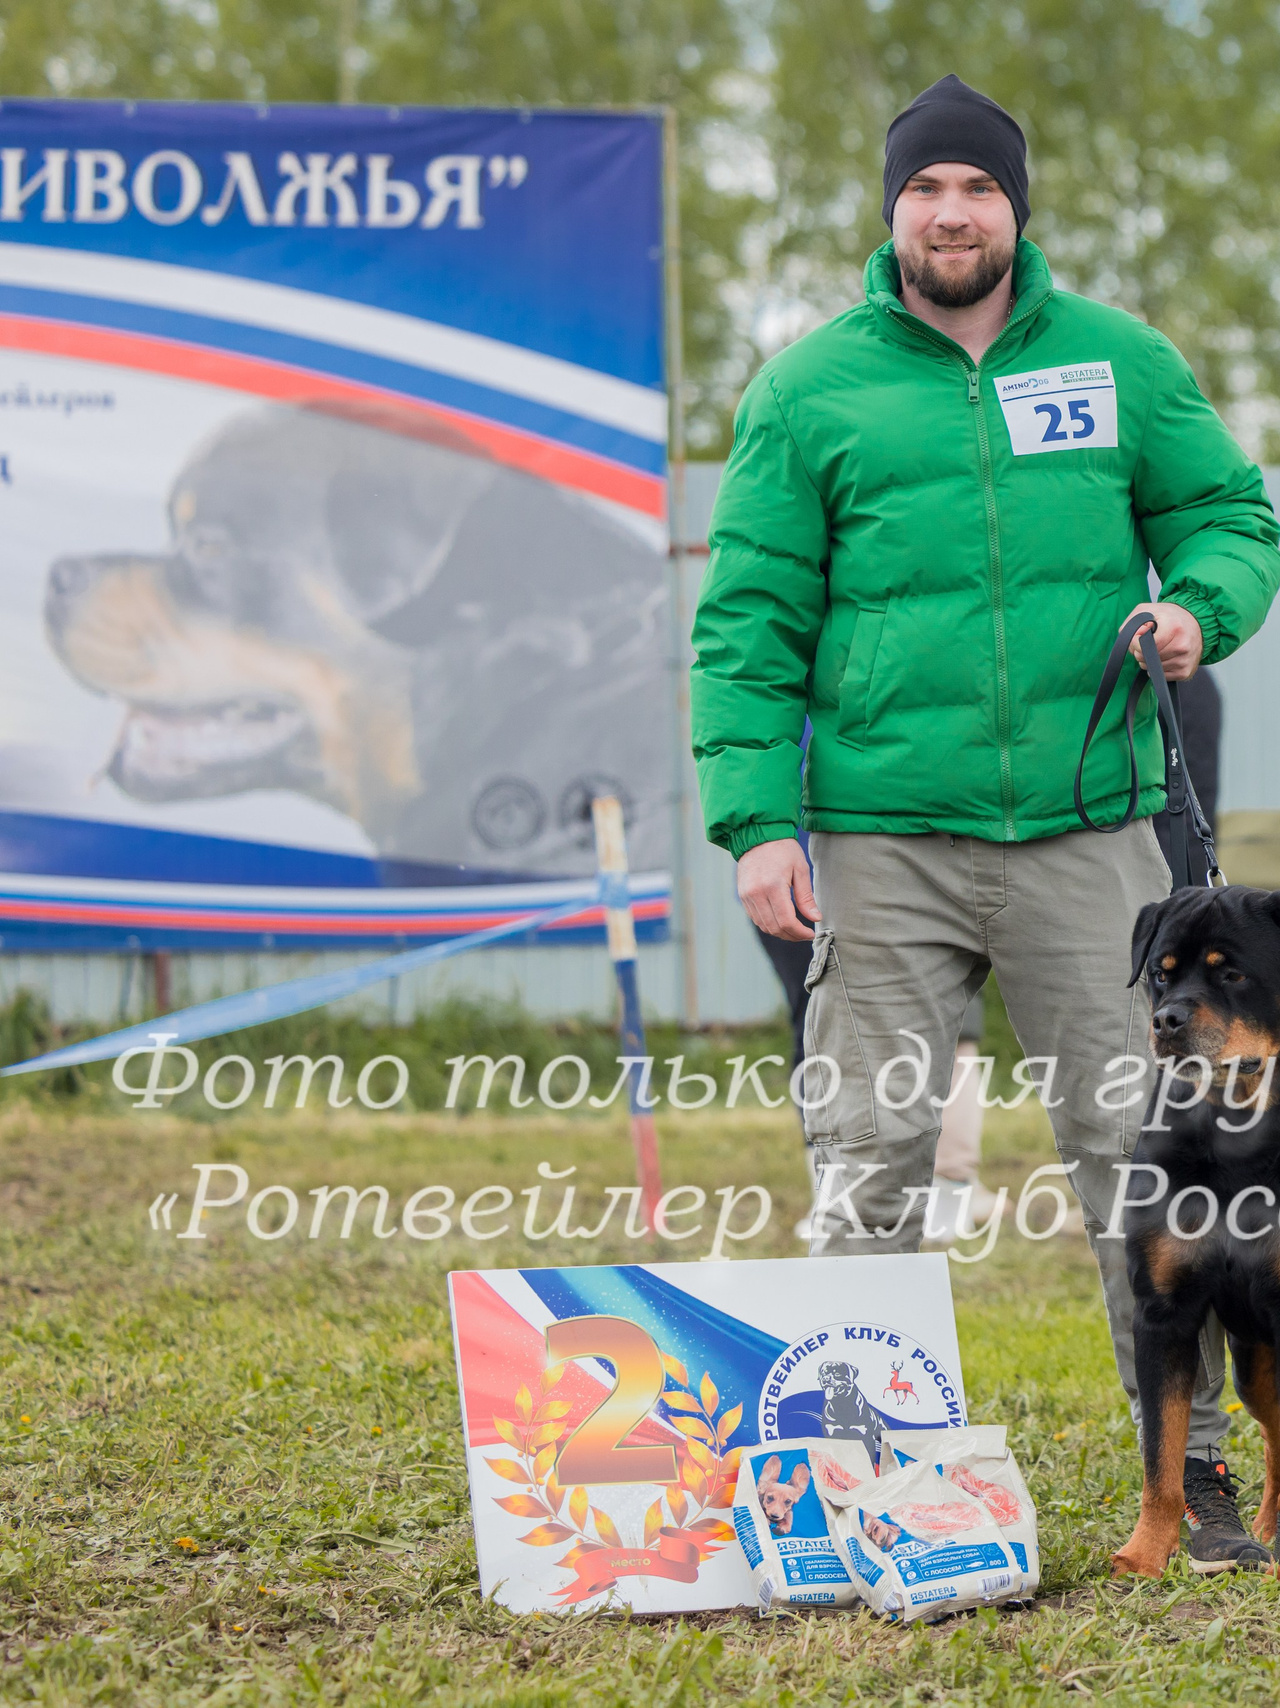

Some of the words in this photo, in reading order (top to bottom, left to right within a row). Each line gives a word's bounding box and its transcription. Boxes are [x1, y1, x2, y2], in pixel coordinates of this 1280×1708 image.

[0, 148, 528, 230] ИВОЛЖЬЯ”
[1033, 399, 1095, 443] 25
[543, 1315, 681, 1488] 2
[763, 1332, 830, 1441] РОТВЕЙЛЕР
[843, 1327, 901, 1348] КЛУБ
[910, 1348, 962, 1428] РОССИИ
[917, 1585, 957, 1597] STATERA
[931, 1565, 962, 1575] ЛОСОСЕМ
[797, 1592, 836, 1601] STATERA
